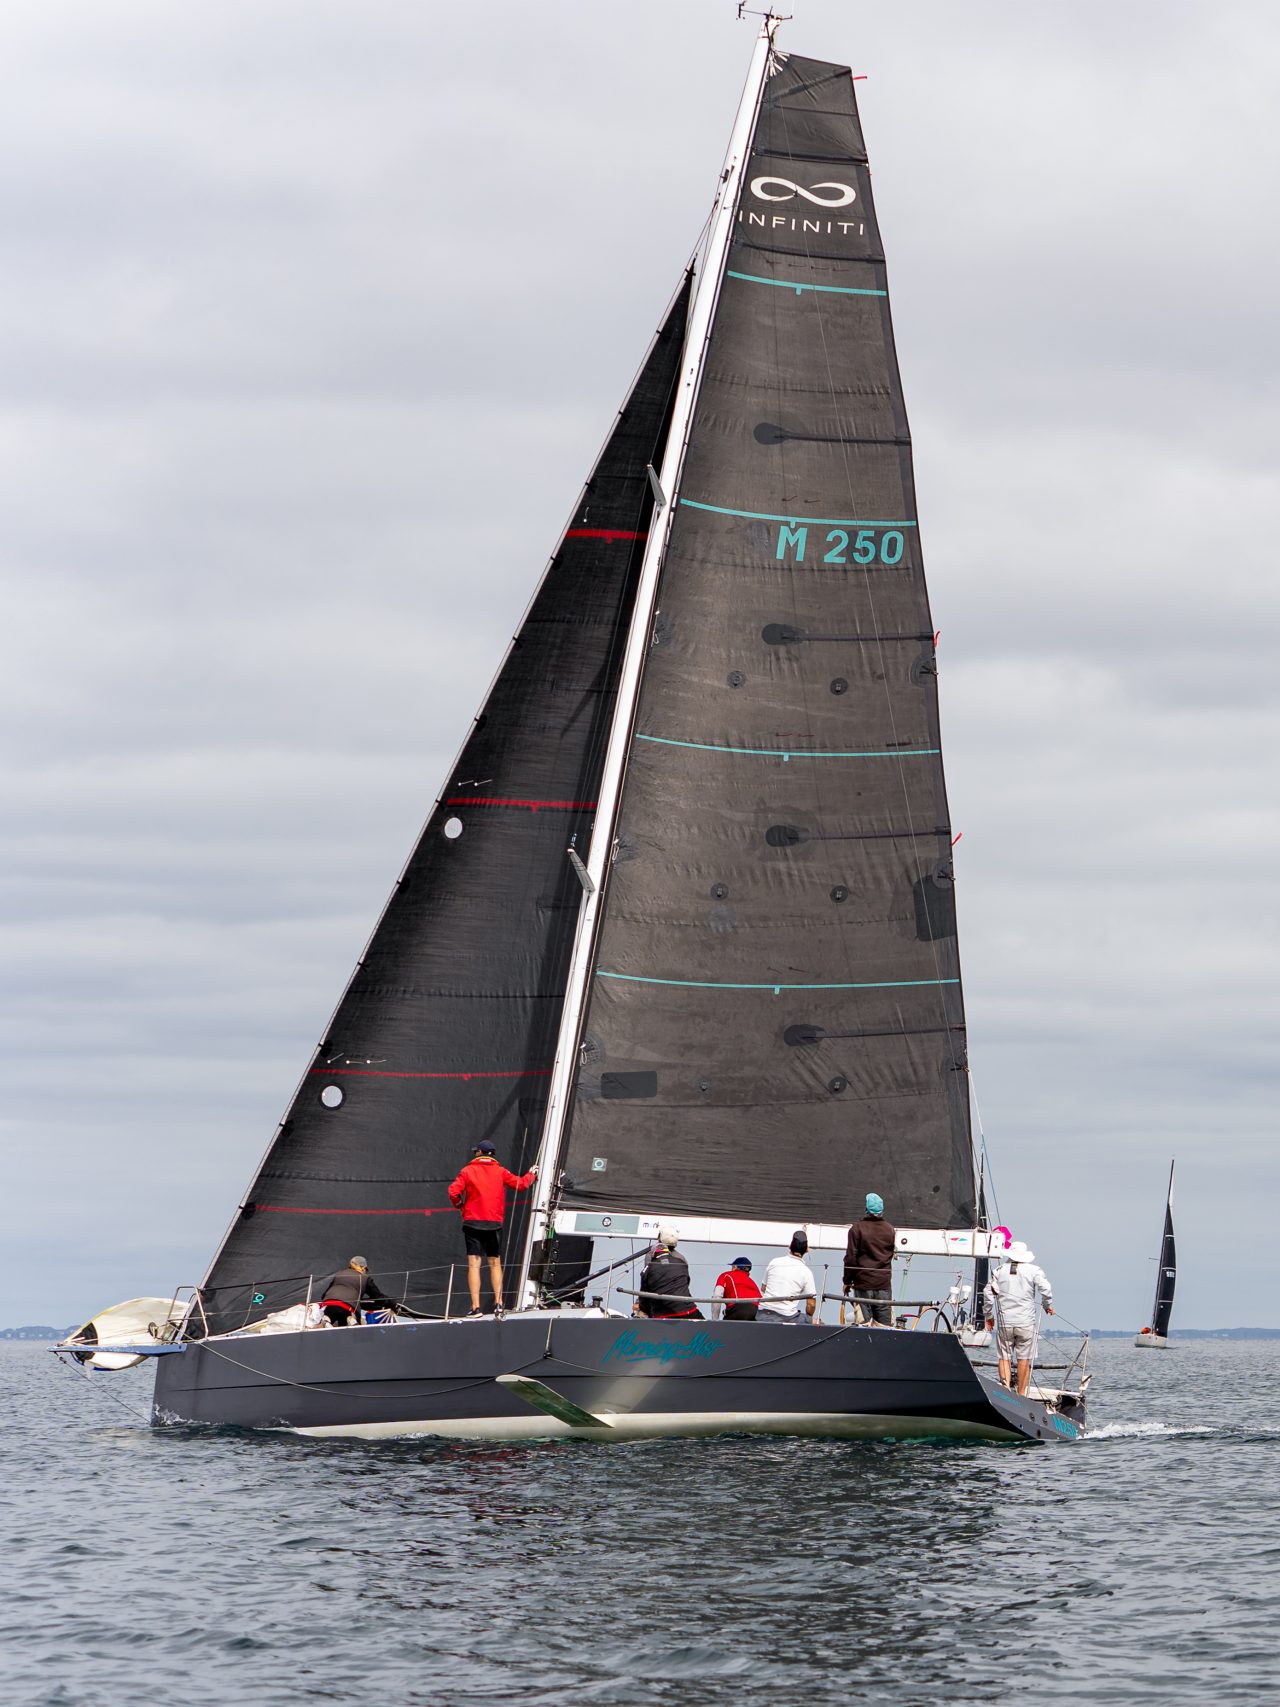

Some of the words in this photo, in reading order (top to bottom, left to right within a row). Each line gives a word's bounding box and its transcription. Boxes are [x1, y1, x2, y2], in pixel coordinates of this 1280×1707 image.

[738, 210, 864, 236] INFINITI
[776, 525, 808, 562] M
[823, 529, 904, 565] 250
